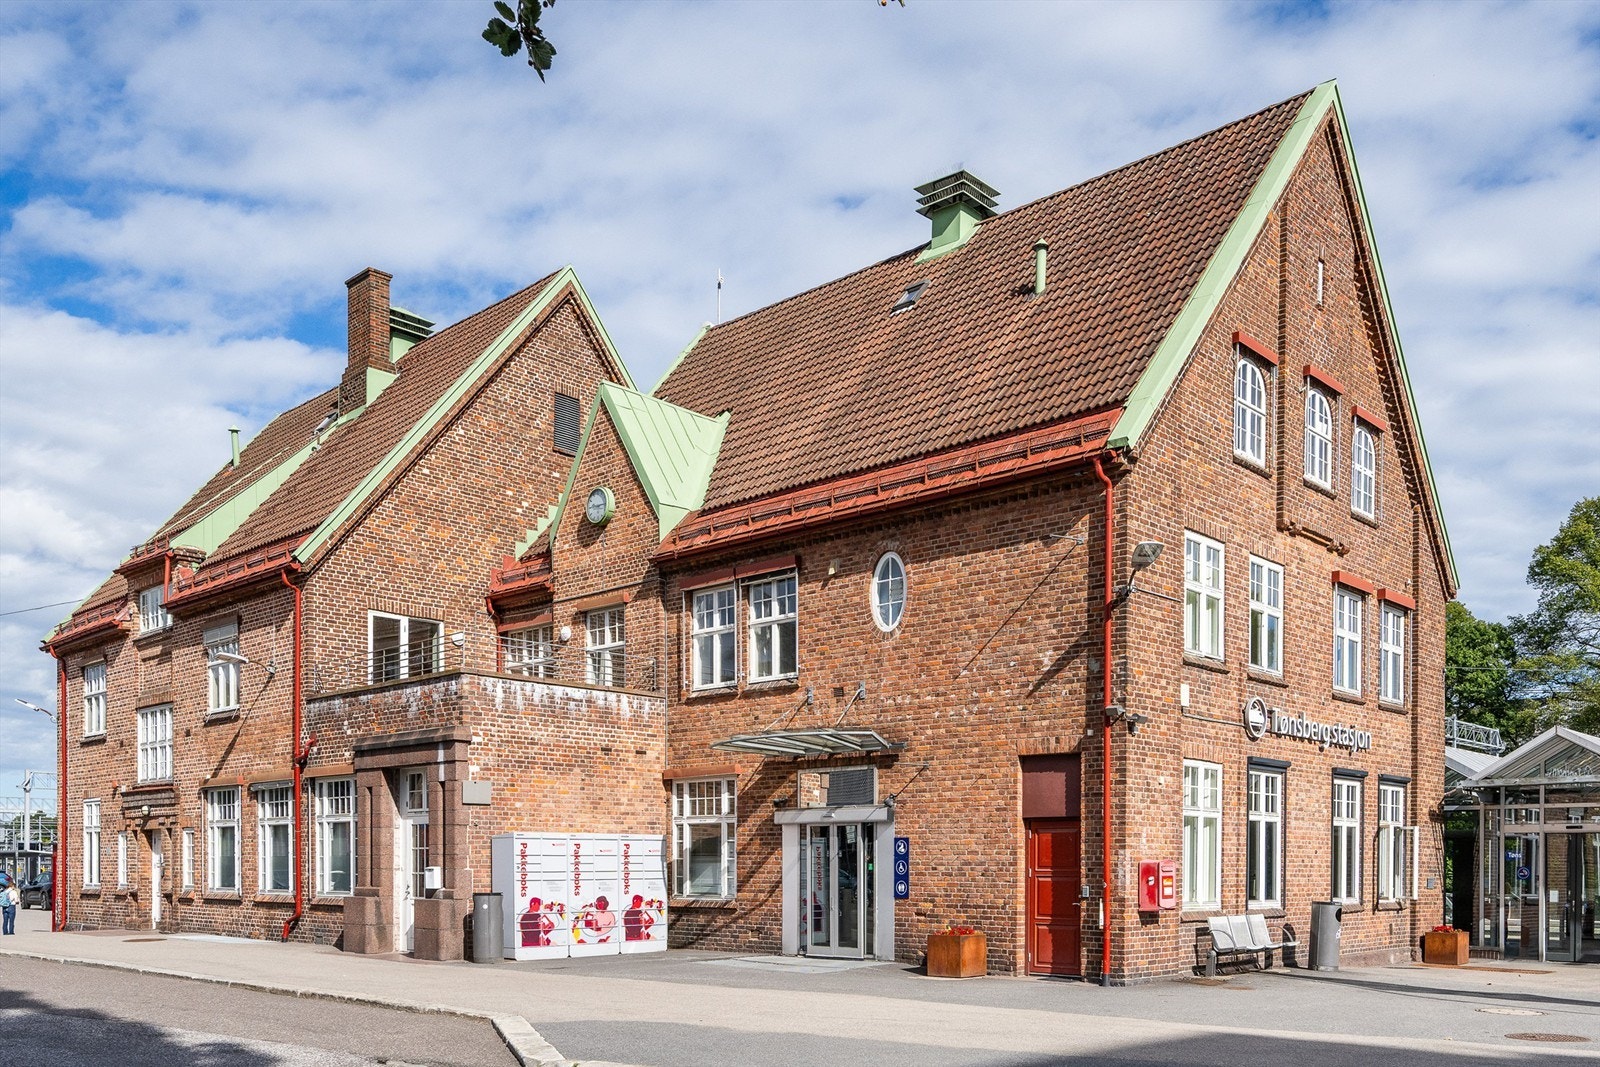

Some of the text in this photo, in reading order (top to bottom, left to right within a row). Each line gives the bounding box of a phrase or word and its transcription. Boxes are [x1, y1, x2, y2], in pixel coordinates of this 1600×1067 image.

[1270, 707, 1372, 752] Tønsberg stasjon
[520, 842, 528, 897] Pakkeboks
[573, 843, 581, 897] Pakkeboks
[623, 843, 631, 895] Pakkeboks
